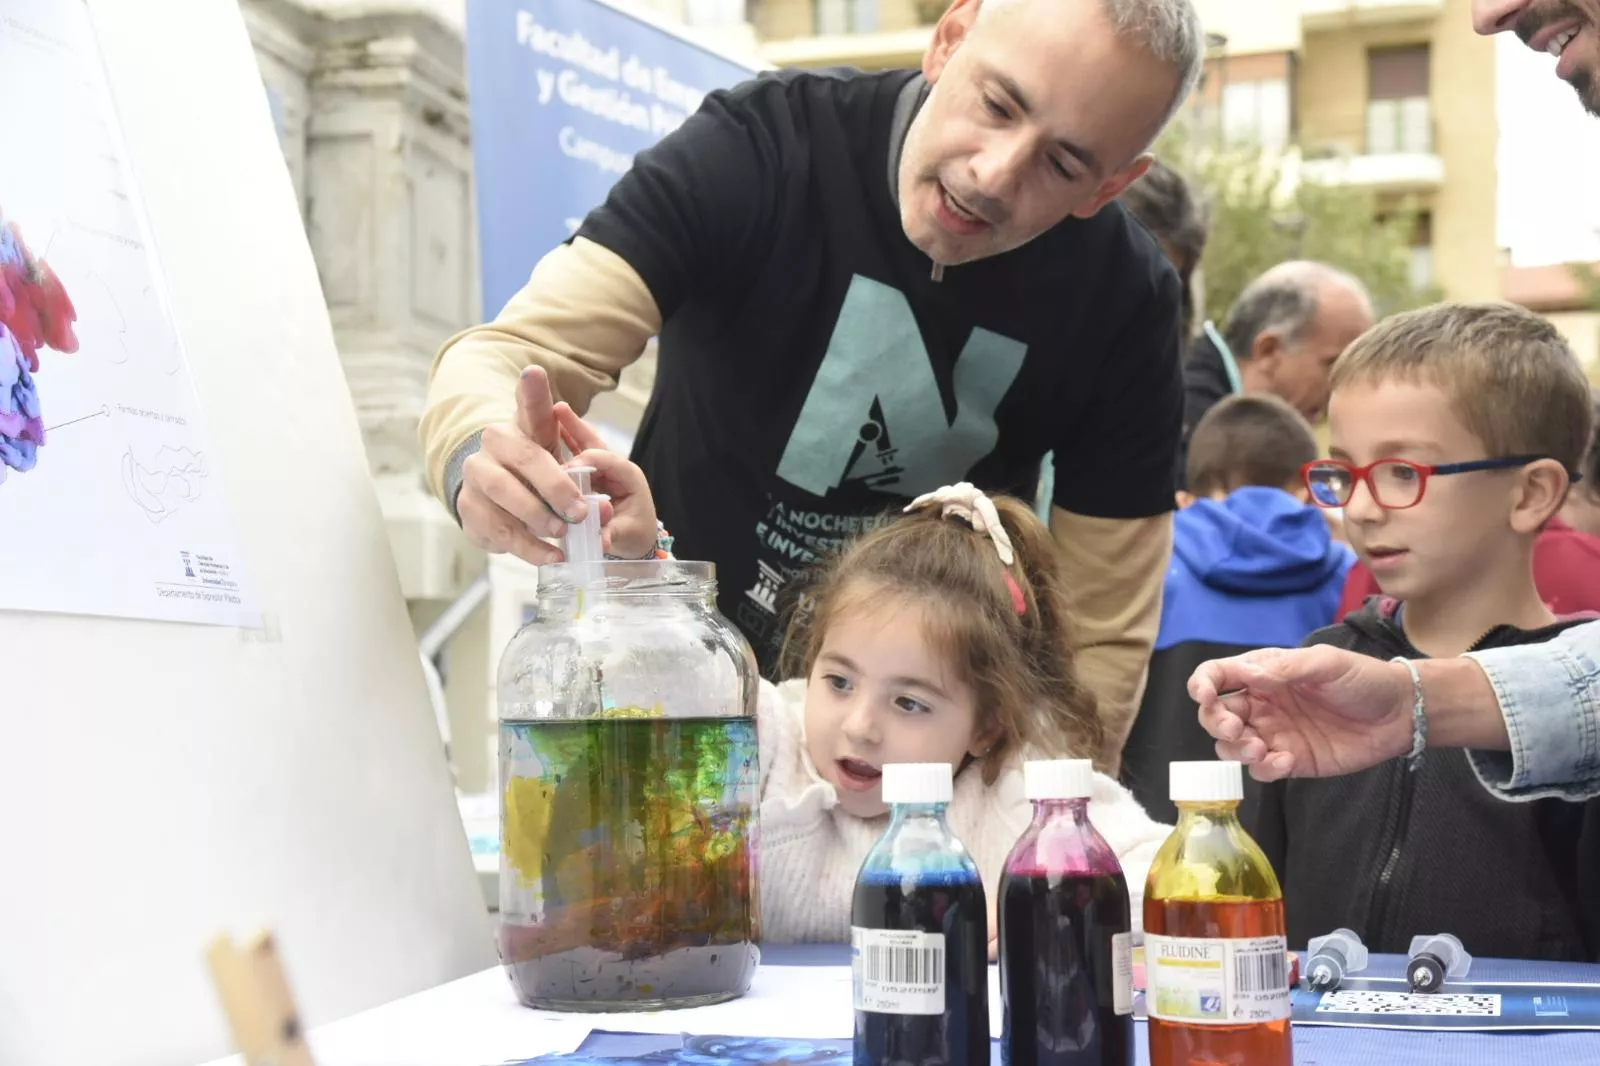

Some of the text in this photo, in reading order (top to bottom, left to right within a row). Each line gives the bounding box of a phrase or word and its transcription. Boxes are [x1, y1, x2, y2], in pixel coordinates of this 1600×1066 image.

[535, 68, 555, 105] y
[790, 509, 861, 533] NOCHE
[1161, 944, 1210, 959] FLUIDINE
